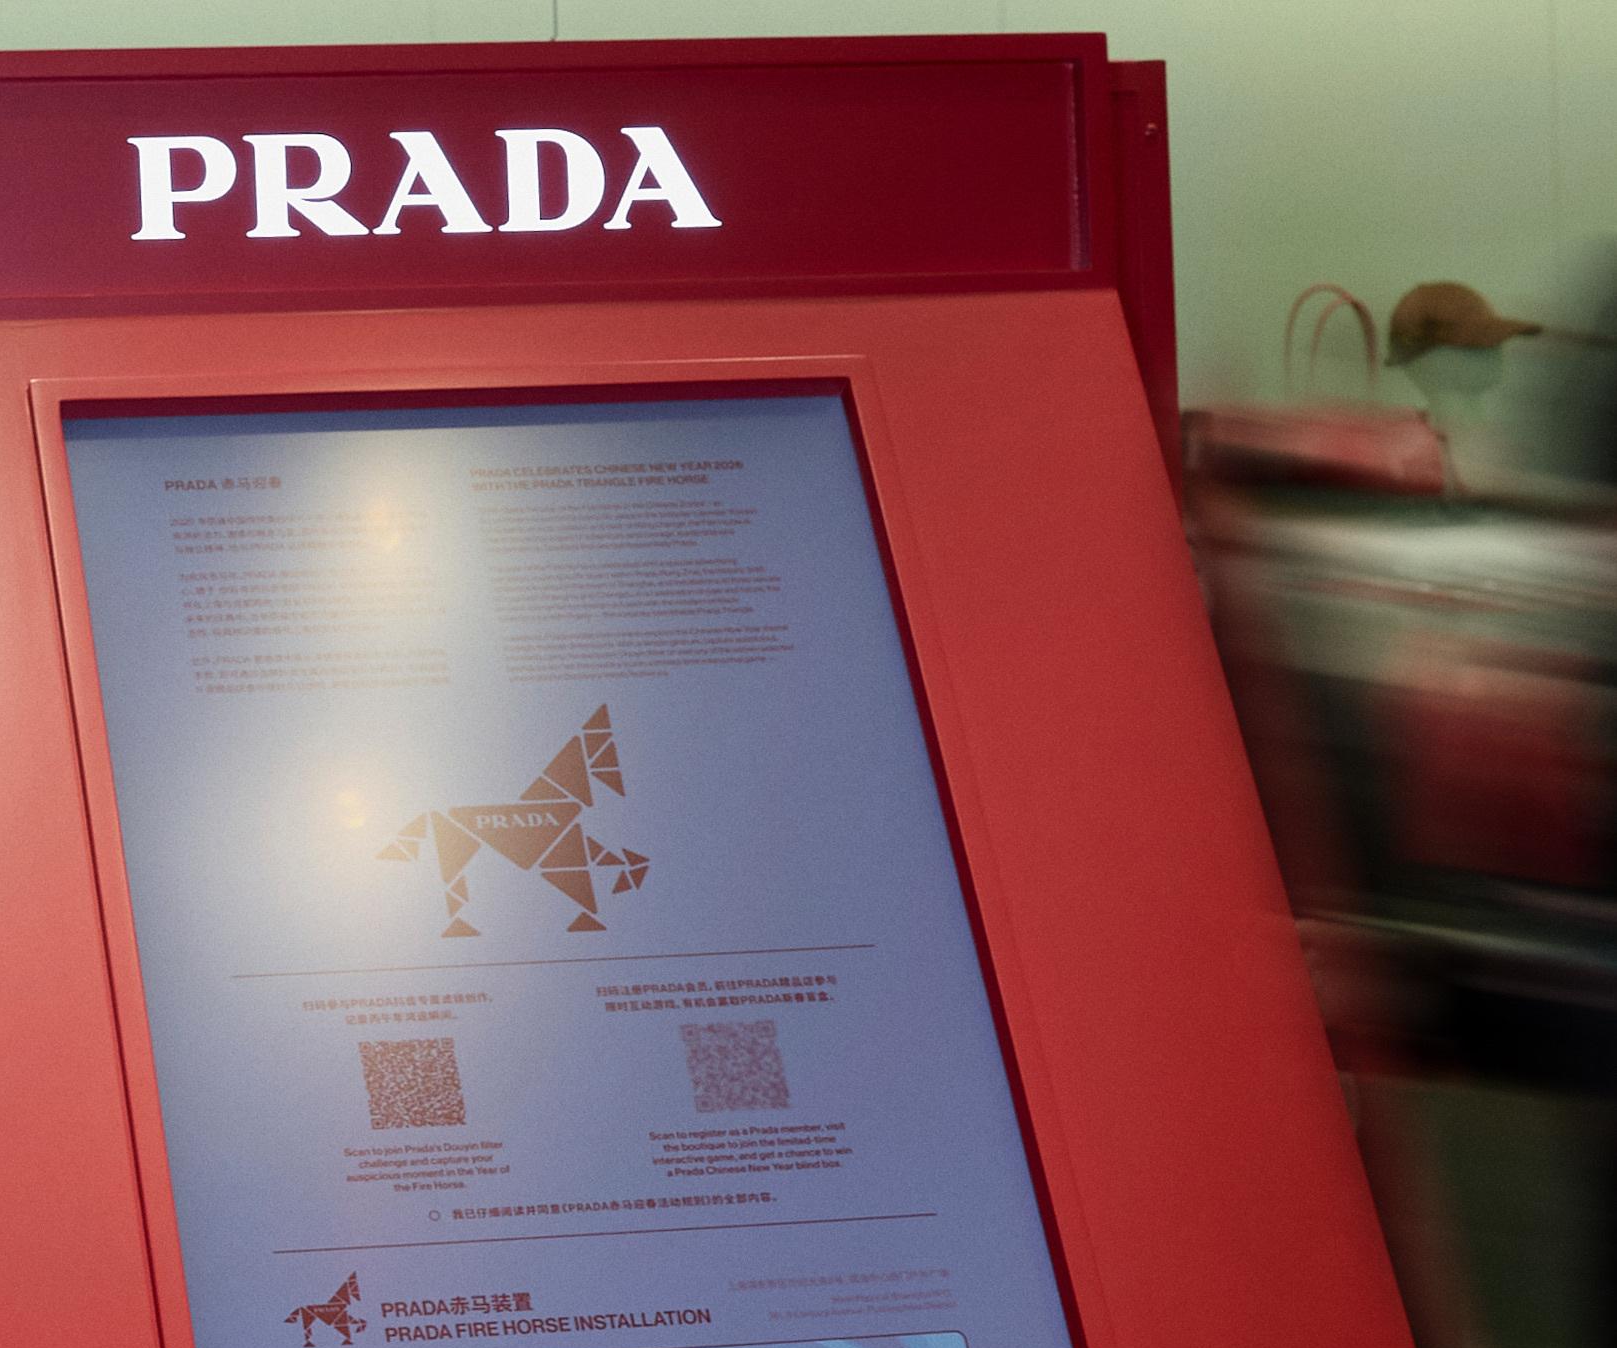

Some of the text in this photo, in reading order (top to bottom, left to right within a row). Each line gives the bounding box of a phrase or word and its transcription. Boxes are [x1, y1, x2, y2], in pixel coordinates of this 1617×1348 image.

[126, 126, 723, 241] PRADA
[164, 479, 218, 491] PRADA
[475, 812, 560, 829] PRADA
[649, 1131, 675, 1141] Scan
[676, 1131, 687, 1140] to
[689, 1129, 726, 1140] register
[749, 1126, 778, 1135] Prada
[343, 1147, 370, 1157] Scan
[443, 1142, 478, 1153] Douyin
[664, 1144, 680, 1153] the
[681, 1142, 726, 1152] boutique
[759, 1138, 775, 1147] the
[358, 1159, 407, 1169] challenge
[410, 1156, 429, 1166] and
[430, 1156, 469, 1166] capture
[653, 1155, 704, 1165] interactive
[739, 1151, 757, 1161] and
[785, 1149, 821, 1158] chance
[346, 1172, 401, 1183] auspicious
[402, 1168, 444, 1179] moment
[456, 1167, 474, 1176] the
[475, 1165, 497, 1175] Year
[499, 1164, 510, 1174] of
[674, 1167, 704, 1177] Prada
[706, 1166, 746, 1175] Chinese
[748, 1164, 770, 1173] New
[772, 1162, 793, 1171] Year
[393, 1183, 411, 1193] the
[412, 1182, 432, 1192] Fire
[381, 1292, 533, 1318] PRADA赤马装置
[385, 1308, 712, 1343] PRADA FIRE HORSE INSTALLATION
